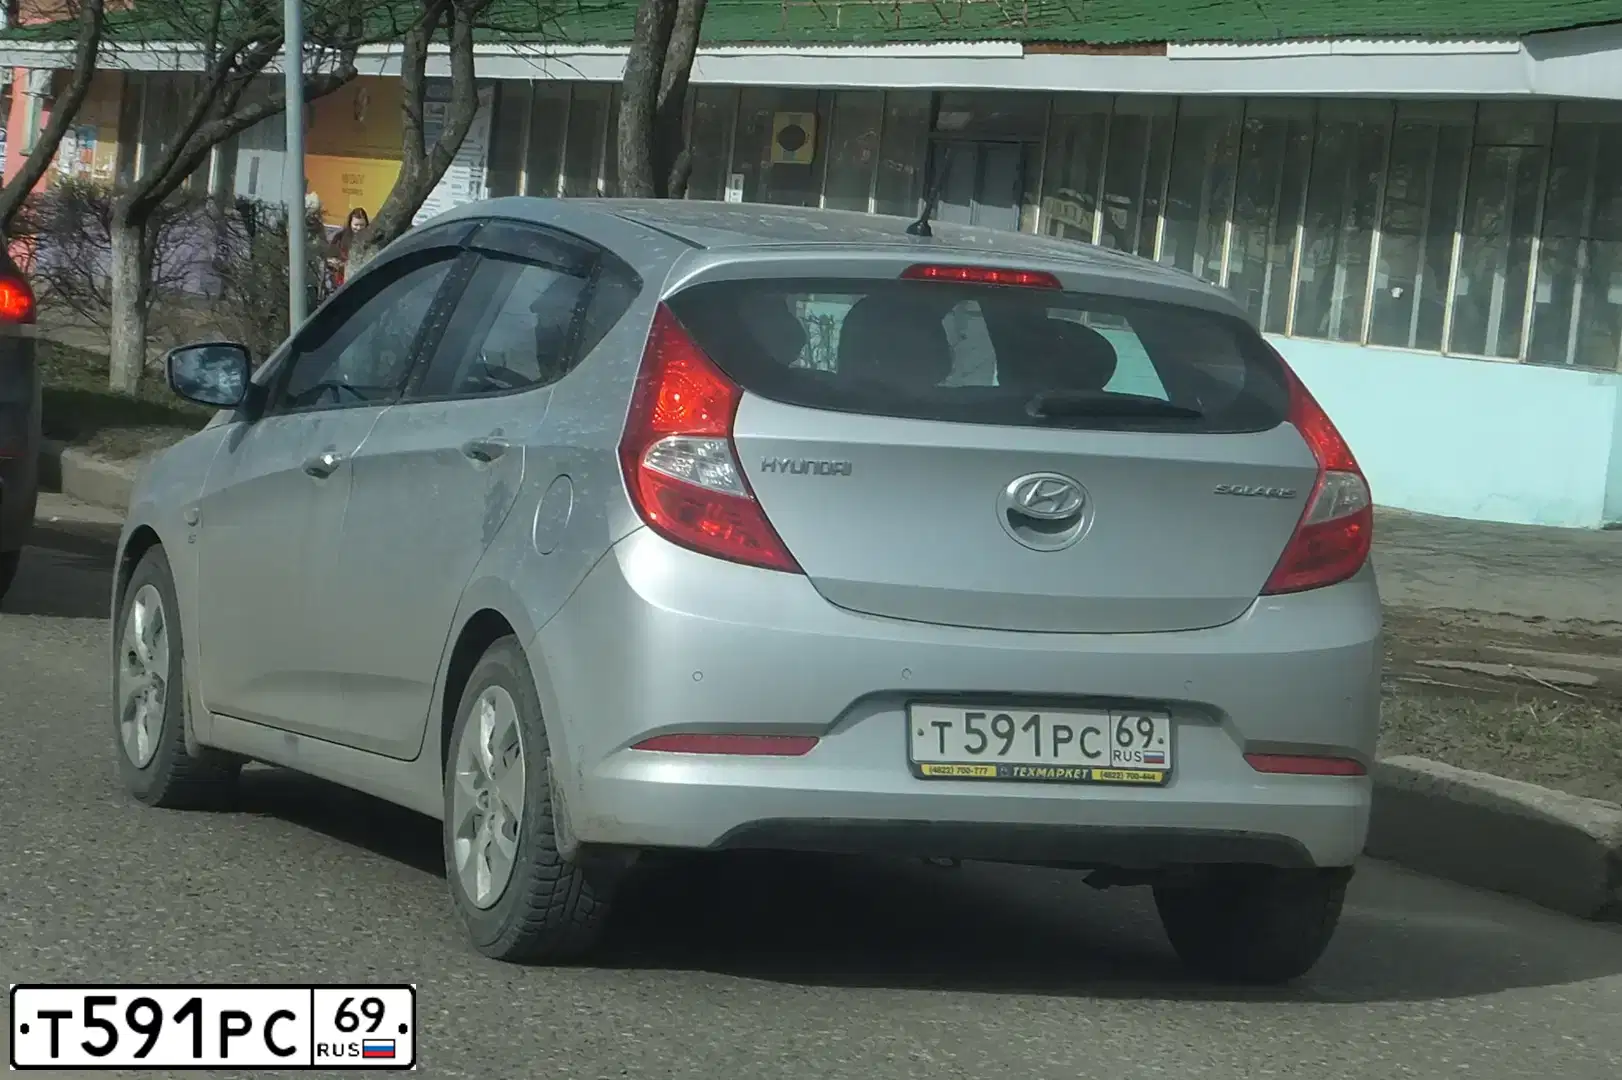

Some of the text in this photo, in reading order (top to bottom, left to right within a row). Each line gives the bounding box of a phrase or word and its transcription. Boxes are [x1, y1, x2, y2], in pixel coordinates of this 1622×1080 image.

[760, 457, 852, 476] HYUNDAI
[1116, 716, 1155, 749] 69
[1113, 750, 1142, 763] RUS
